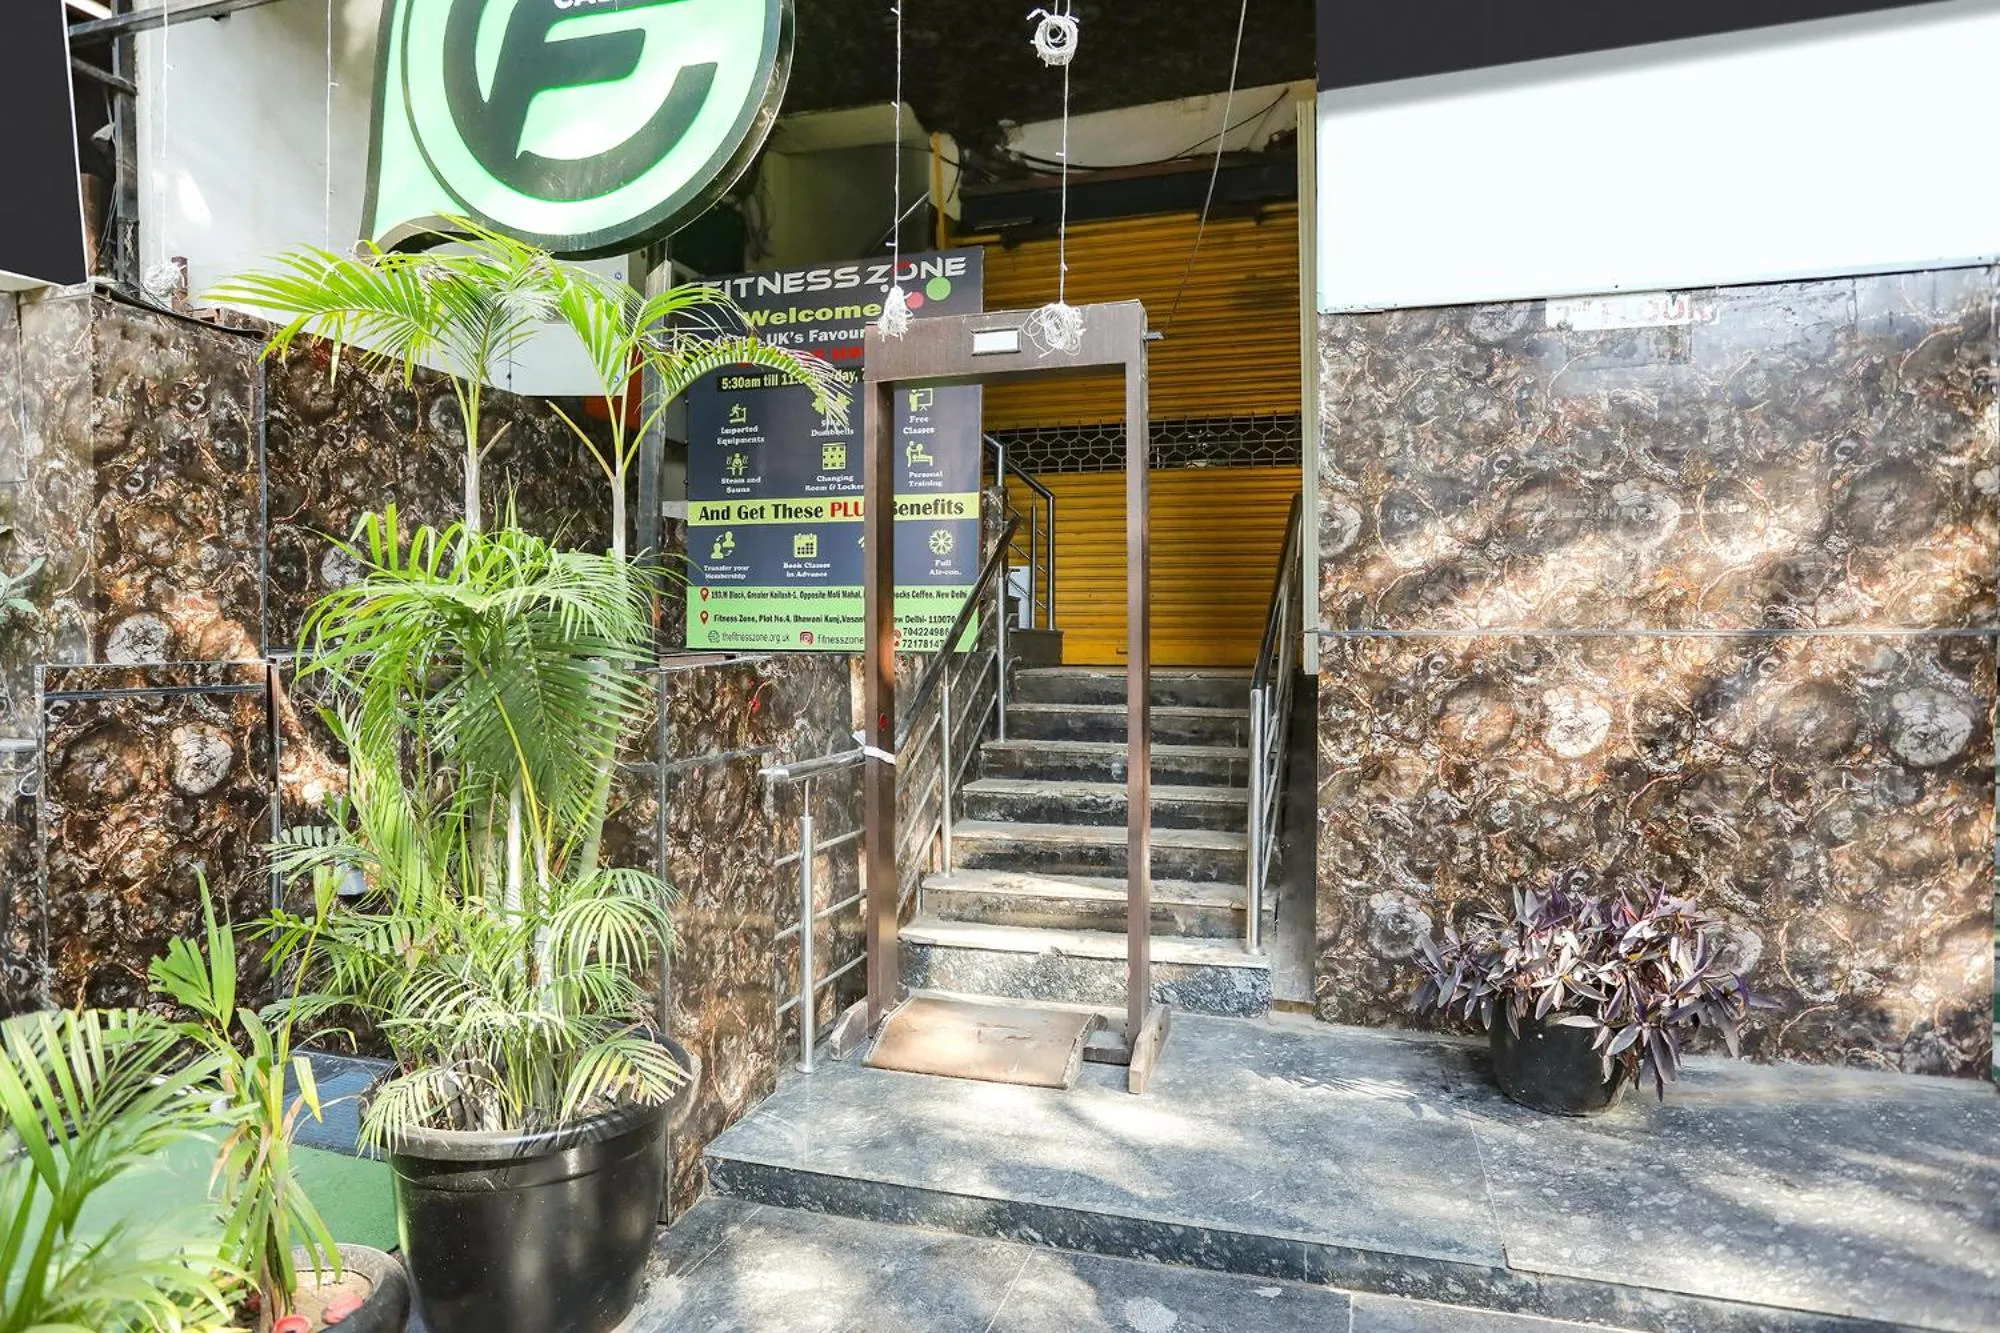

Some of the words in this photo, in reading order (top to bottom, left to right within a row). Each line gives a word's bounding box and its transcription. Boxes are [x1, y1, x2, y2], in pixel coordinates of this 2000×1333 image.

[744, 303, 882, 328] Welcome
[766, 330, 804, 346] UK's
[809, 328, 865, 343] Favour
[721, 376, 761, 390] 5:30am
[763, 373, 779, 387] till
[909, 414, 930, 424] Free
[720, 424, 759, 435] Imported
[903, 426, 935, 435] Classes
[717, 435, 765, 446] Equipments
[817, 473, 854, 483] Changing
[909, 471, 944, 479] Personal
[909, 480, 944, 488] Training
[699, 503, 730, 521] And
[737, 503, 766, 520] Get
[773, 502, 824, 519] These
[830, 501, 865, 518] PLU
[902, 639, 945, 649] 72178147
